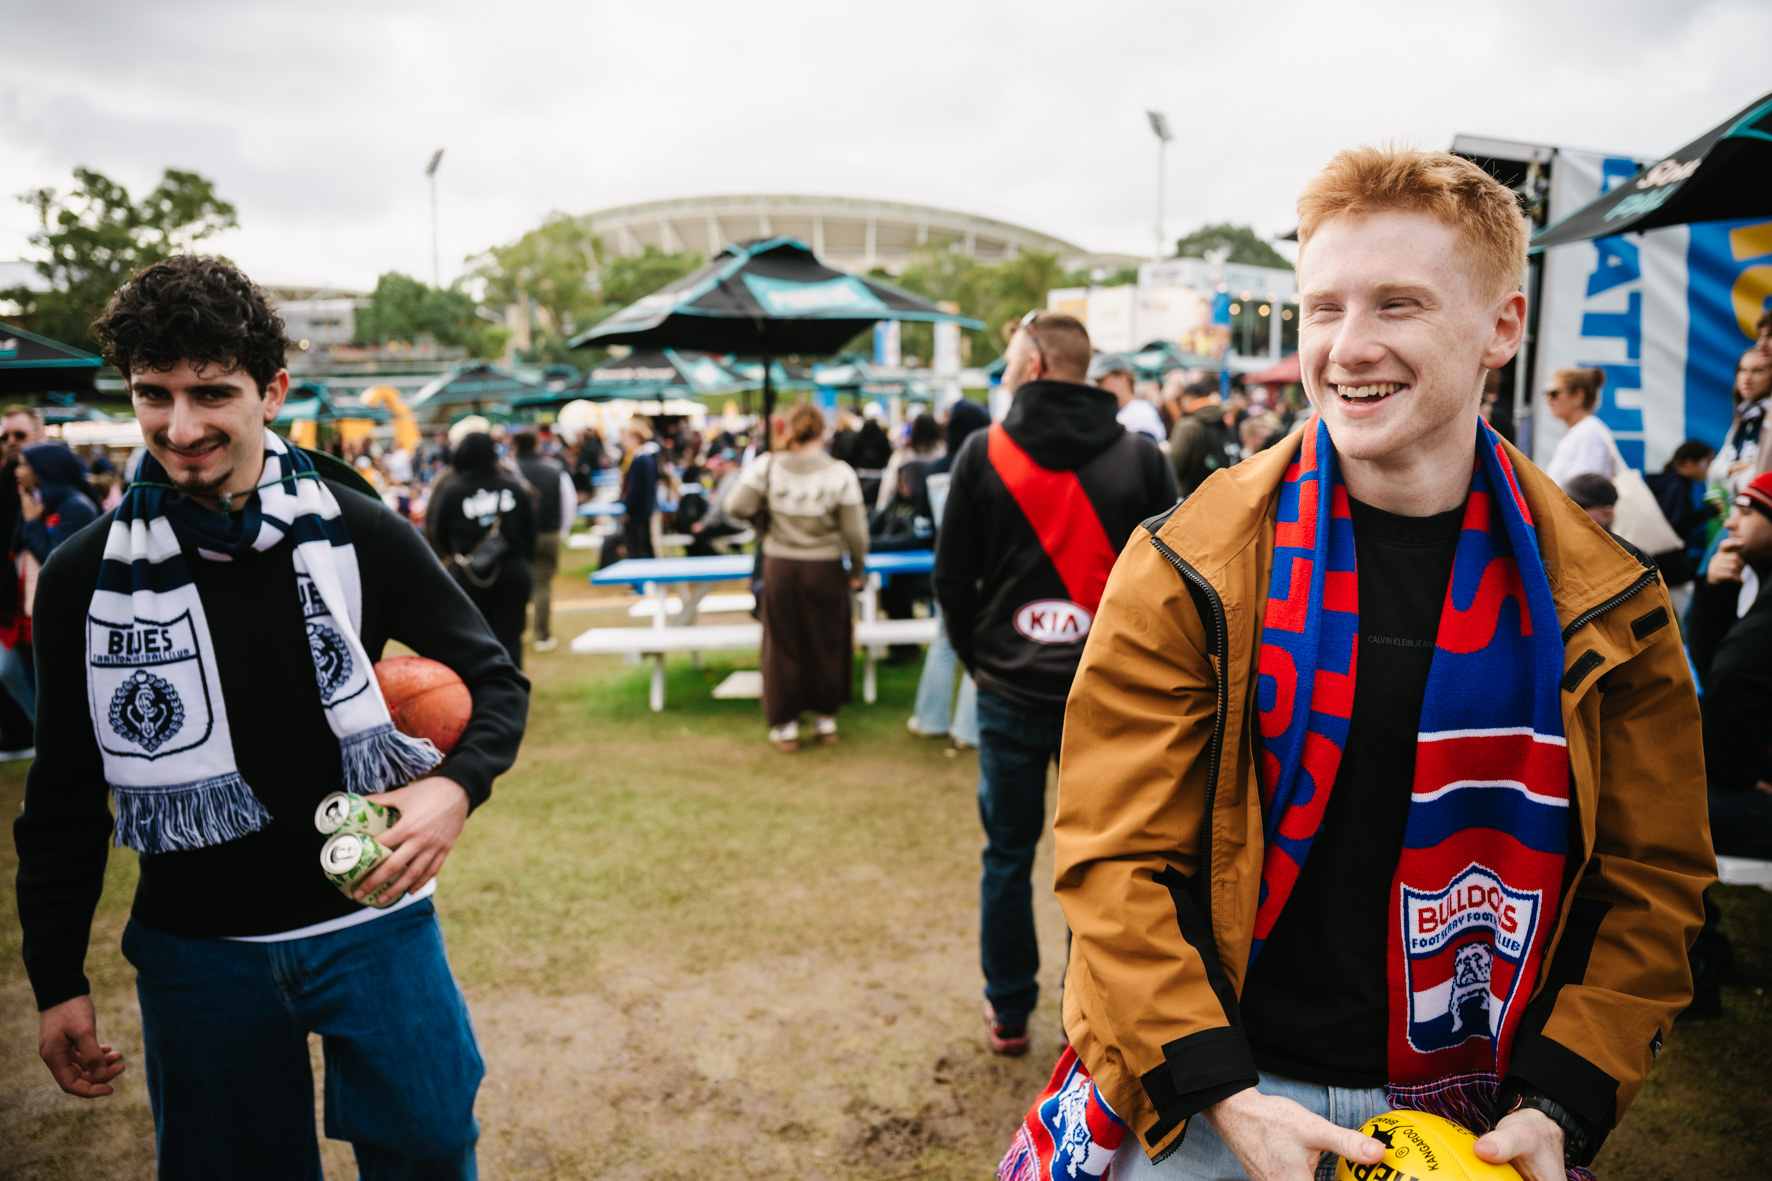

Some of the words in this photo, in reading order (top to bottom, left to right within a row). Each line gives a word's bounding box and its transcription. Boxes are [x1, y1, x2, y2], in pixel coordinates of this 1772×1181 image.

[1029, 610, 1079, 633] KIA
[1368, 635, 1392, 645] CALVIN
[1393, 637, 1414, 647] KLEIN
[1414, 639, 1434, 648] JEAN
[1402, 1128, 1439, 1172] KANGAROO
